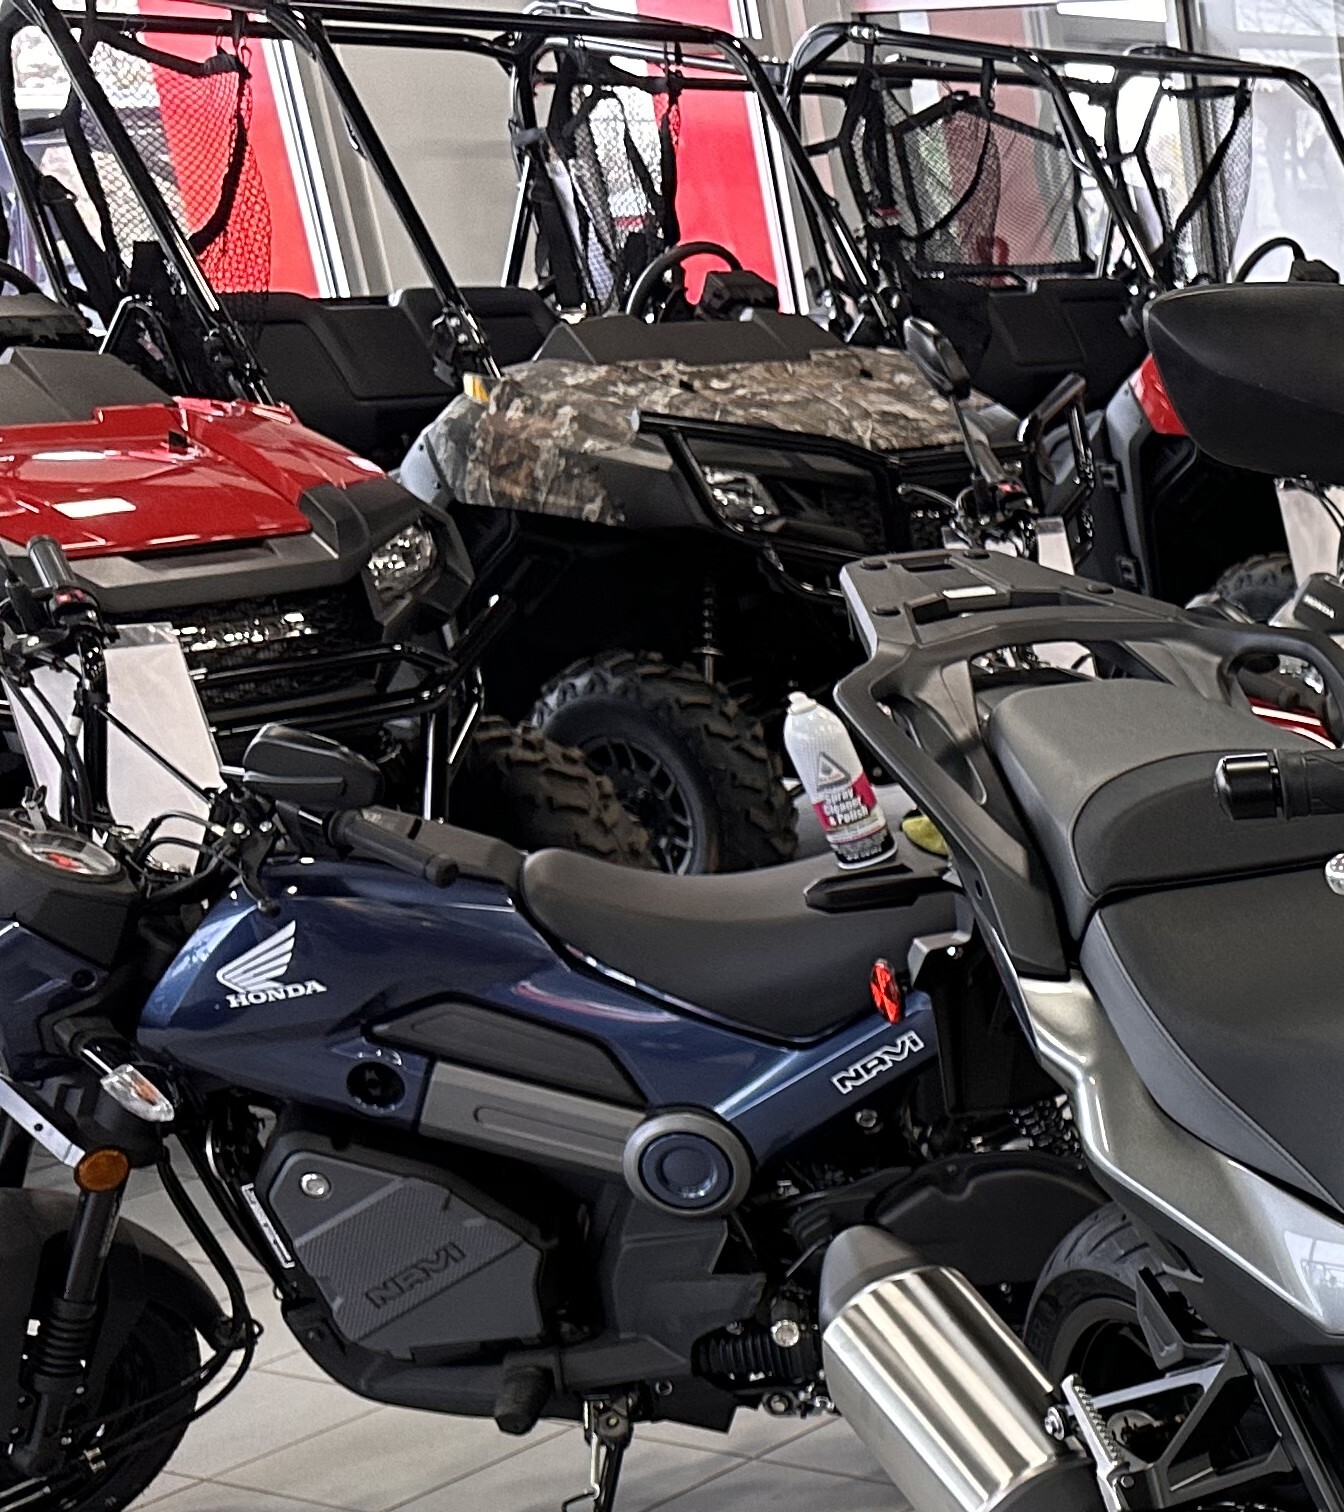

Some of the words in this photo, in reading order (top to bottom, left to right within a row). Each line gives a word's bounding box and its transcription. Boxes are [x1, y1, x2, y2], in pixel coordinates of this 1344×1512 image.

[225, 980, 328, 1009] HONDA
[831, 1029, 925, 1095] NAVI
[364, 1241, 467, 1310] NAVI
